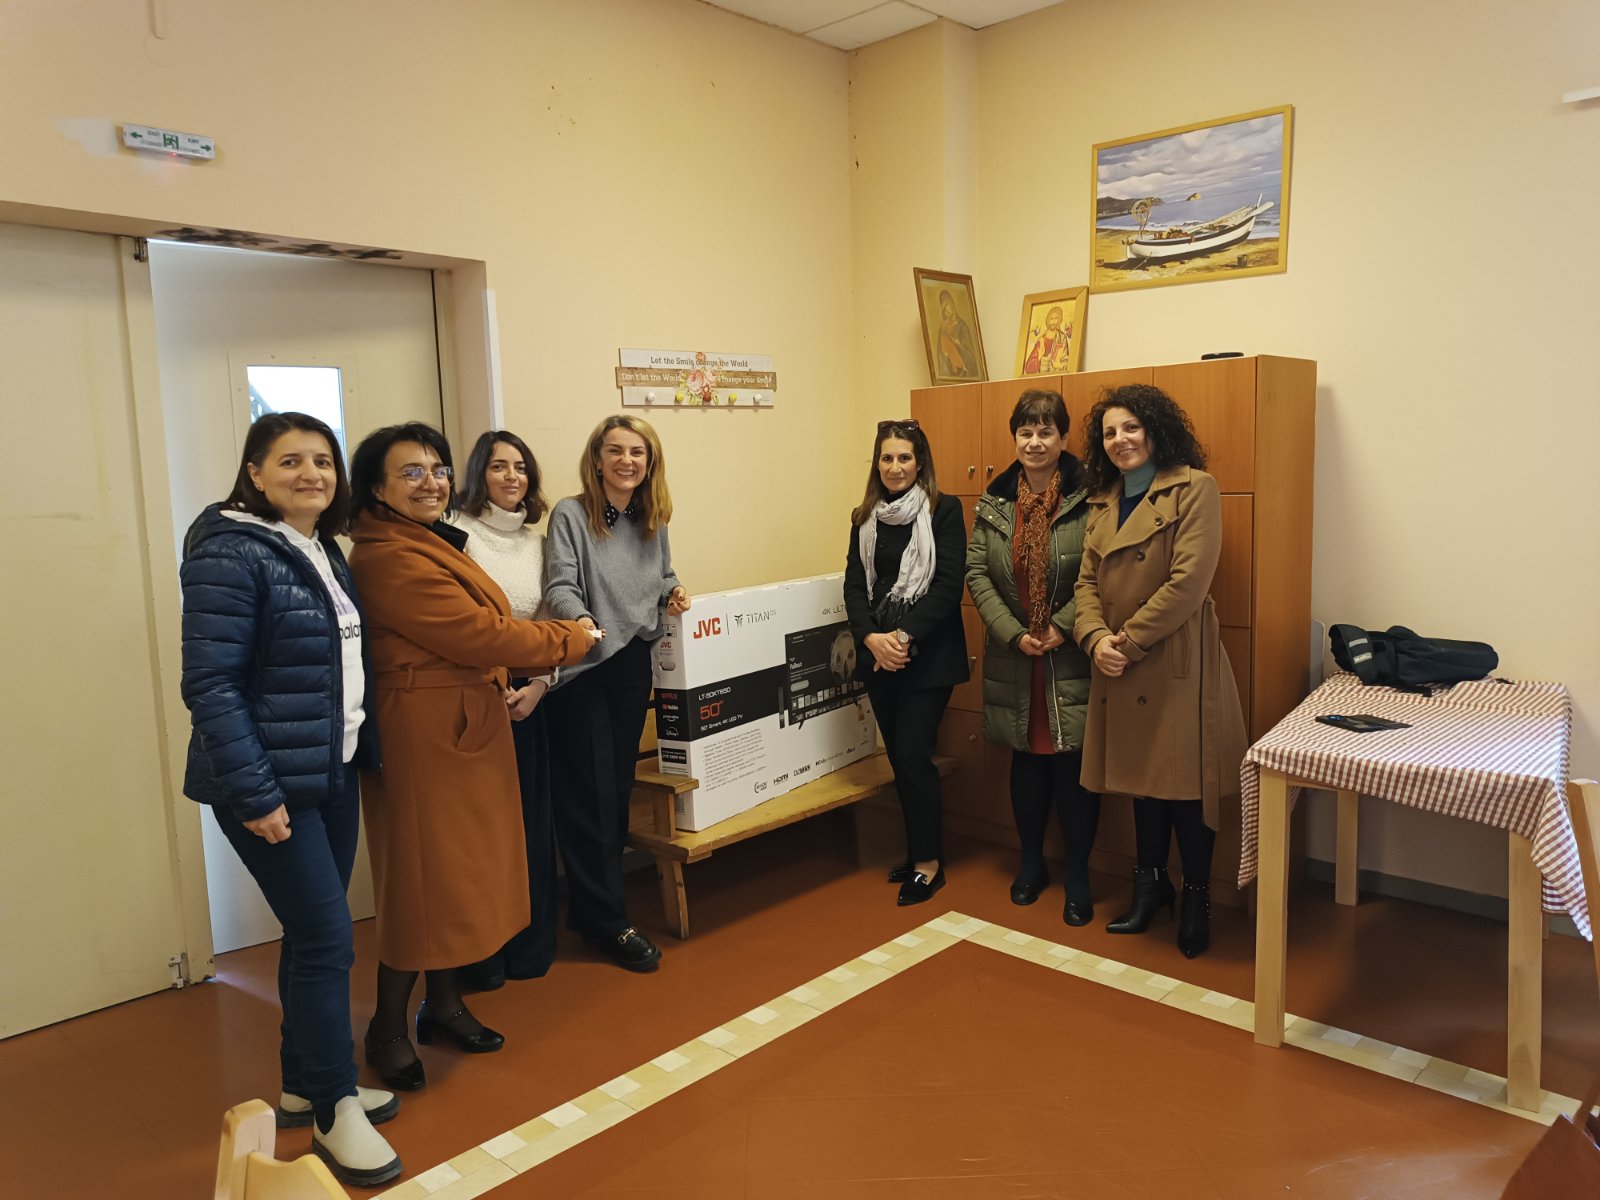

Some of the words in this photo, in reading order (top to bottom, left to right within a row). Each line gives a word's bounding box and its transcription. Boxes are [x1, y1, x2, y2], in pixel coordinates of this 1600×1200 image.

[650, 356, 662, 364] Let
[663, 357, 675, 365] the
[676, 357, 694, 366] Smile
[695, 359, 718, 368] cnge
[719, 359, 730, 367] the
[731, 360, 748, 368] World
[650, 373, 661, 381] the
[821, 607, 832, 615] 4K
[832, 604, 846, 614] ULT
[746, 611, 770, 623] TITAN
[693, 617, 721, 639] JVC
